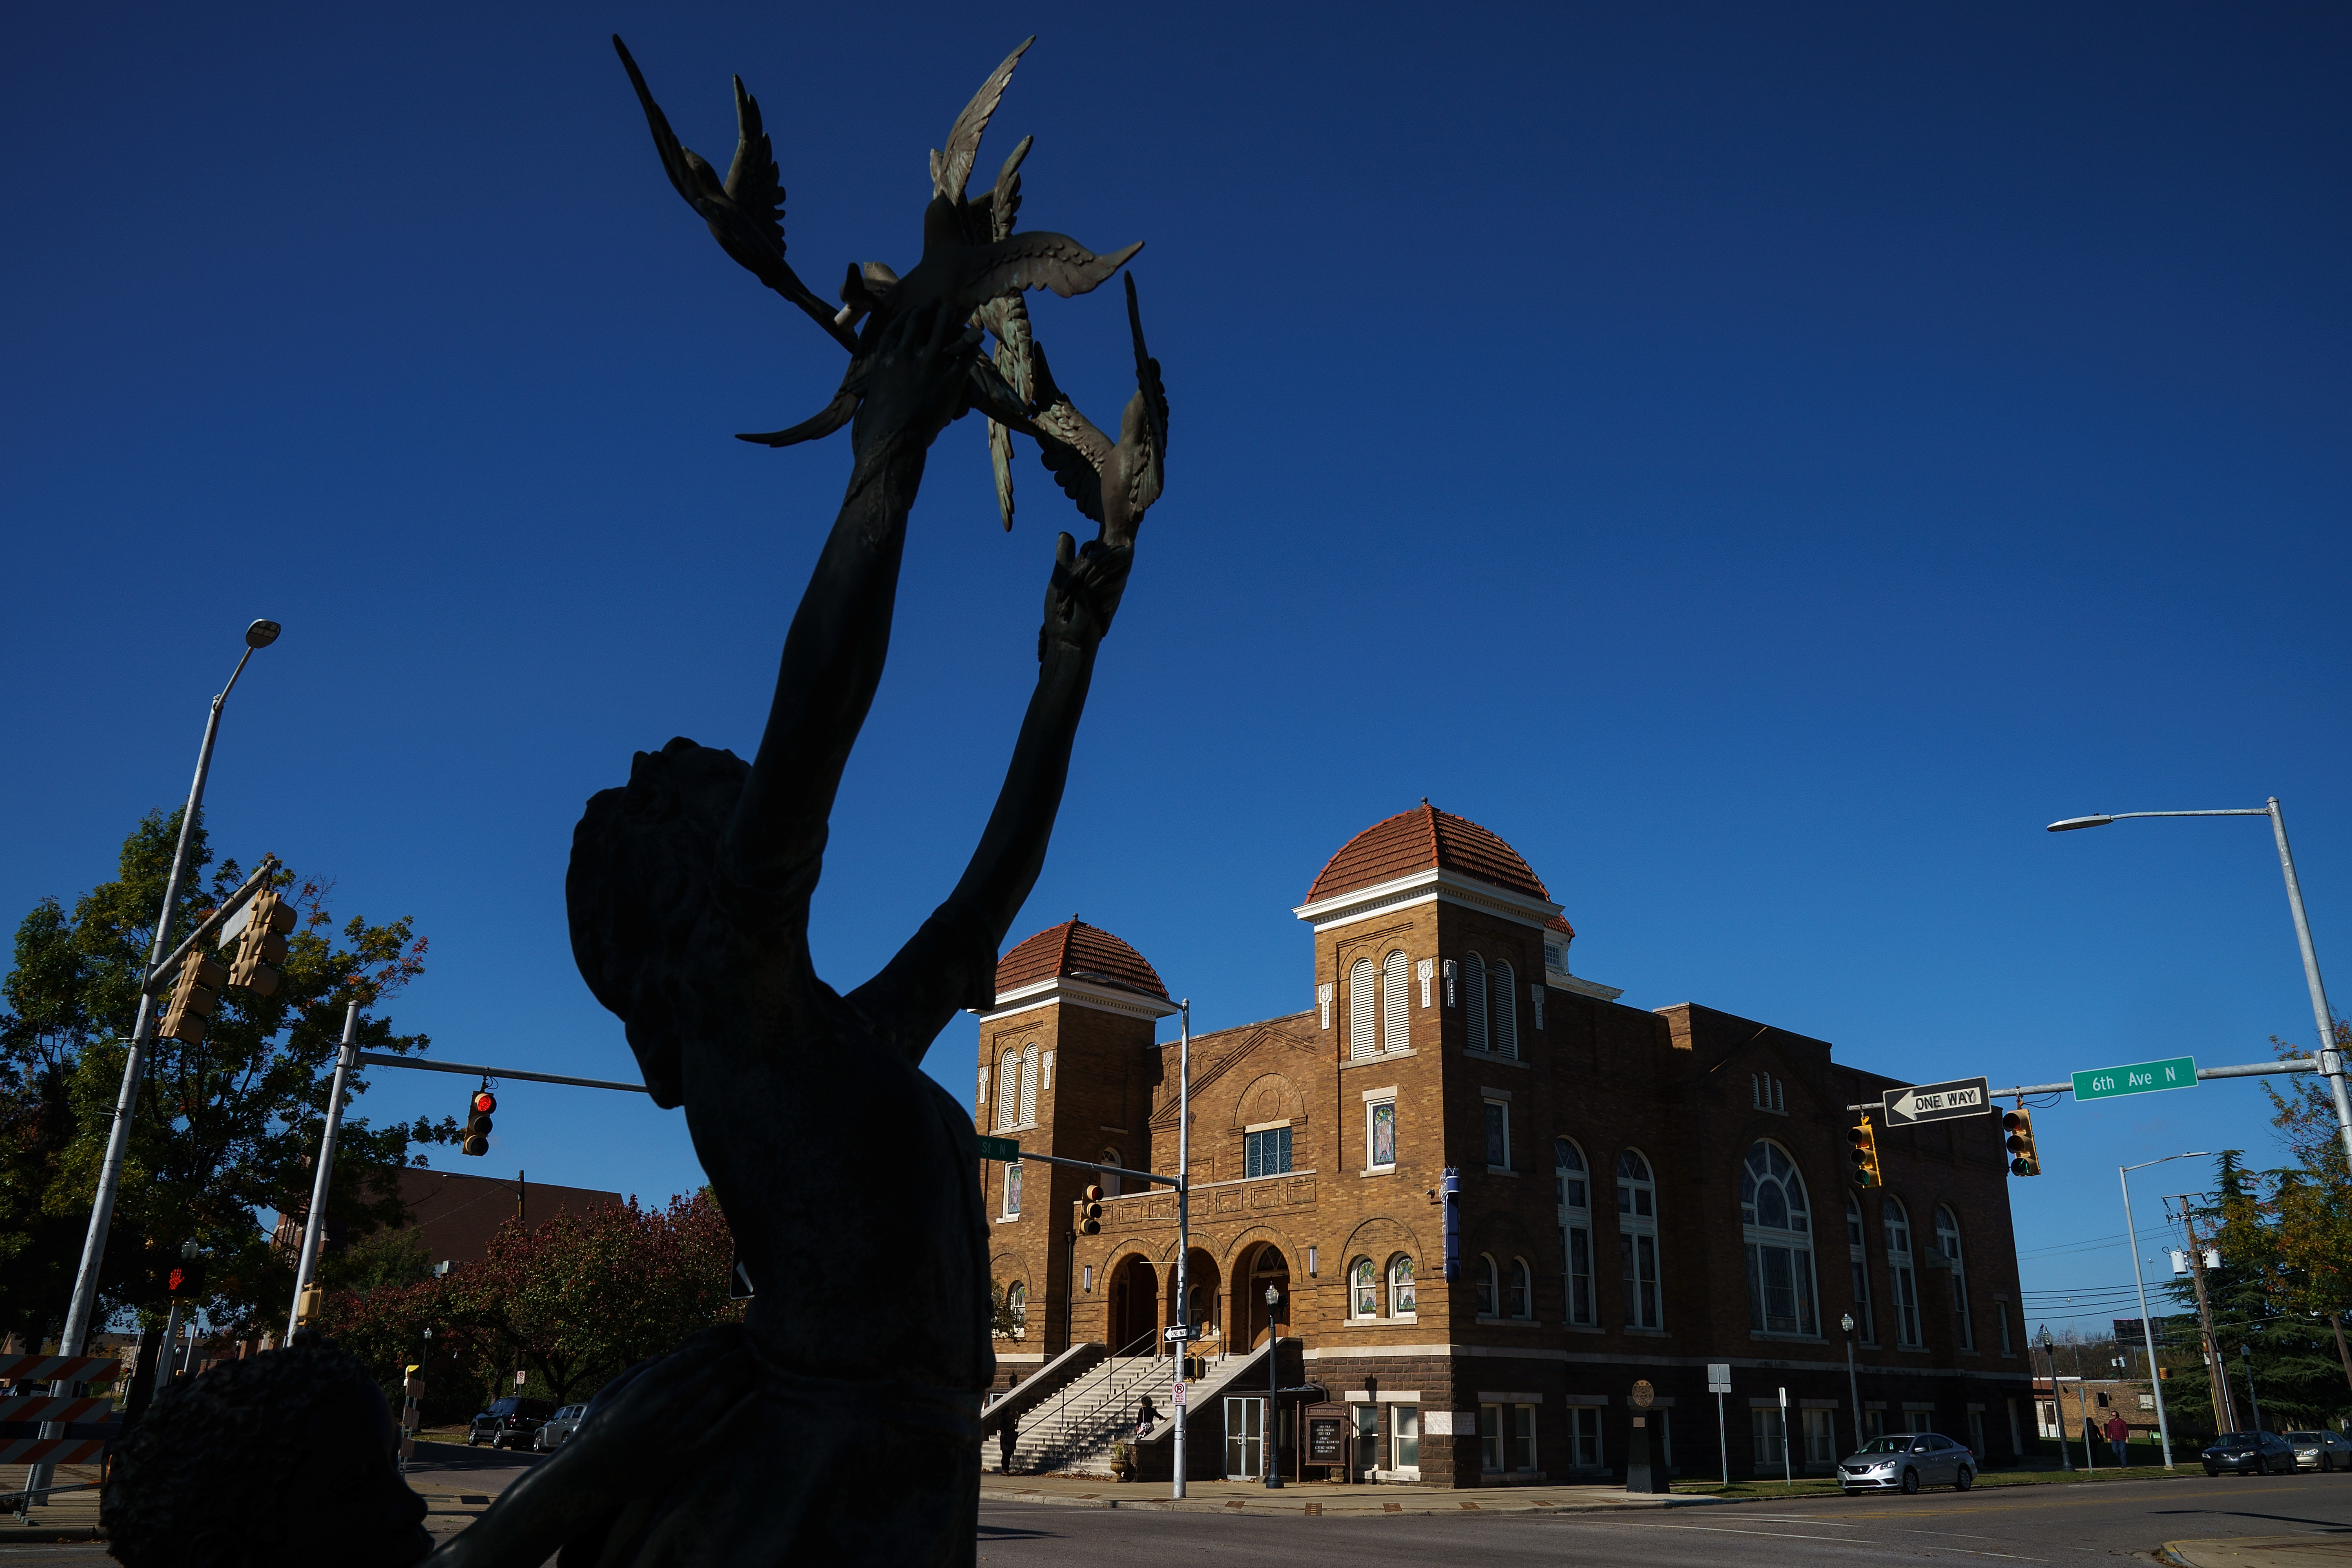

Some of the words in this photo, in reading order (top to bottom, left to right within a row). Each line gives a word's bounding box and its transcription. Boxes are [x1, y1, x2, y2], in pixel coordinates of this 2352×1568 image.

[2092, 1075, 2114, 1092] 6th
[2128, 1072, 2152, 1087] Ave
[2165, 1067, 2175, 1081] N
[1916, 1095, 1941, 1110] ONE
[1947, 1090, 1974, 1106] WAY
[982, 1141, 991, 1153] St
[1000, 1144, 1005, 1155] N
